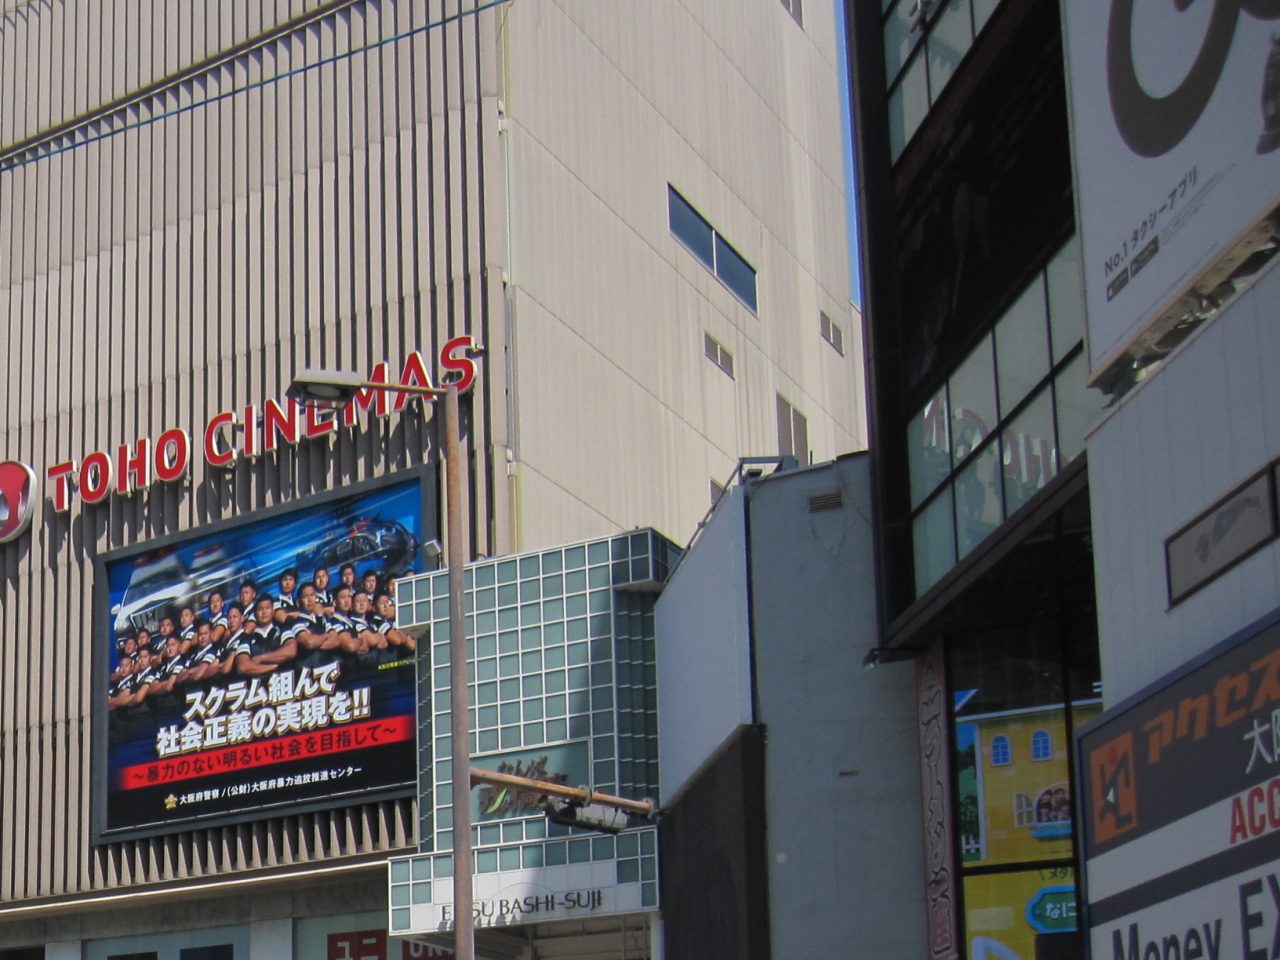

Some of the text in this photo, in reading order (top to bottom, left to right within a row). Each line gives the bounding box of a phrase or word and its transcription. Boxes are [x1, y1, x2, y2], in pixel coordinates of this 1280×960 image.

[47, 335, 479, 514] TOHO CINEMAS
[184, 660, 342, 720] スクラム組んで
